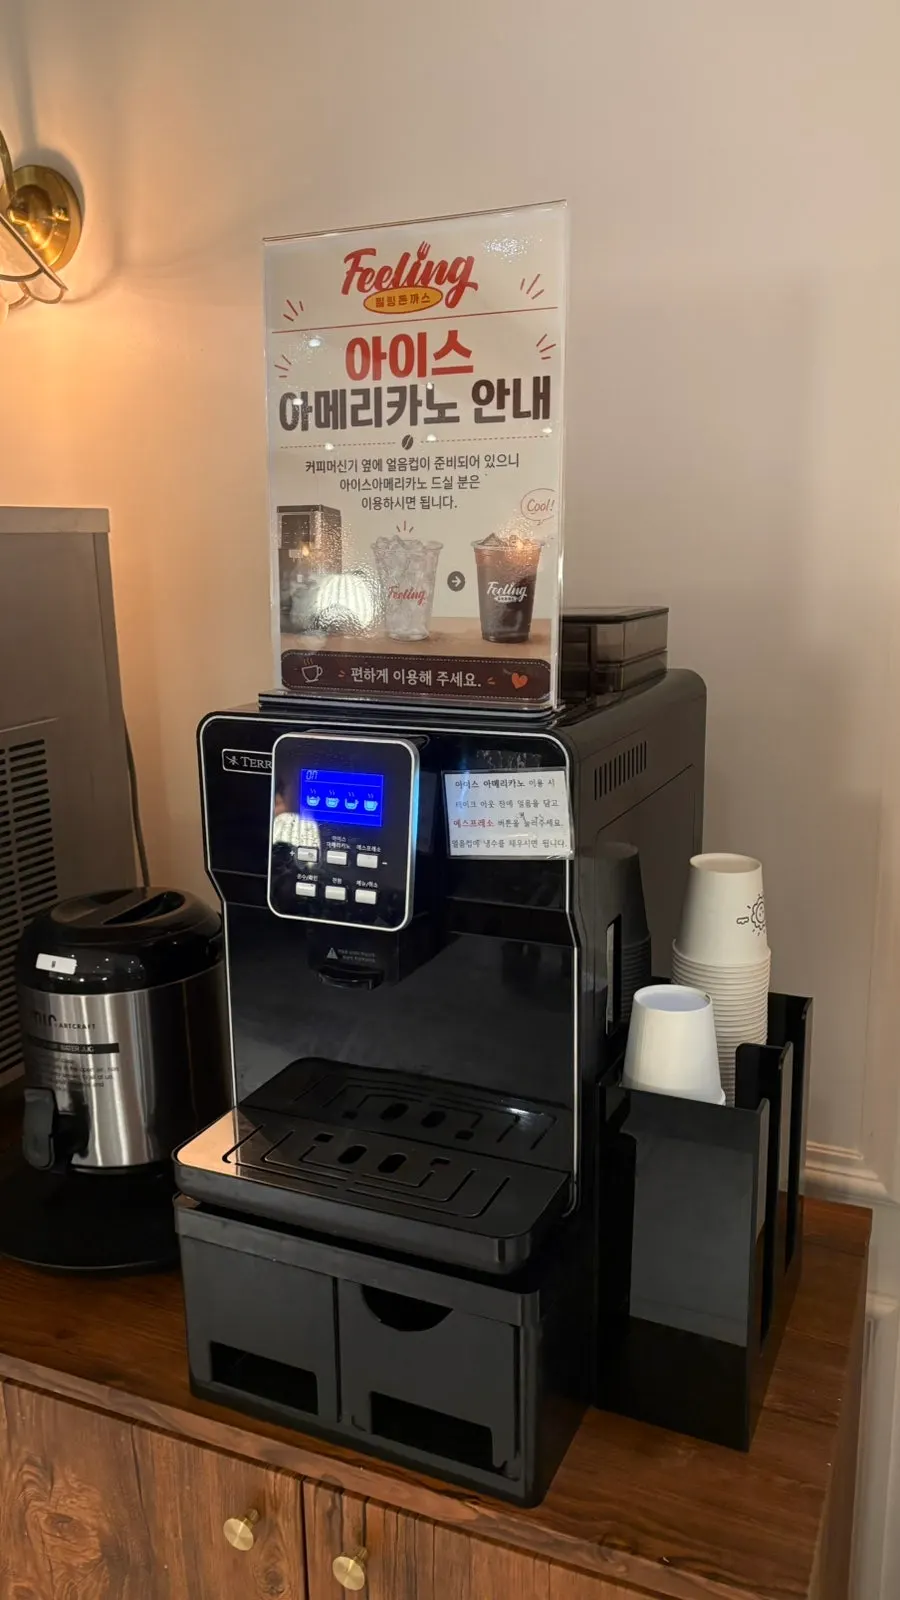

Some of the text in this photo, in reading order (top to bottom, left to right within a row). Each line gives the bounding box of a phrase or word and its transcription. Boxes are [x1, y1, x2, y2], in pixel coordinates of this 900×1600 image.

[341, 242, 479, 309] Feeling
[375, 293, 430, 308] 필링돈까스
[345, 330, 474, 381] 아이스
[279, 375, 551, 431] 아메리카노 안내
[305, 453, 519, 474] 커피머신기 옆에 얼음컵이 준비되어 있으니
[340, 474, 480, 492] 아이스아메리카노 드실 분은
[361, 495, 458, 511] 이용하시면 됩니다.
[527, 498, 555, 512] Cool!
[388, 585, 427, 605] Feeling
[486, 581, 528, 602] Feeling
[351, 667, 482, 688] 편하게 이용해 주세요.
[455, 779, 555, 789] 아이스 아메리카노 이용 시
[453, 818, 495, 828] 에스프레소
[497, 818, 519, 828] 버튼을
